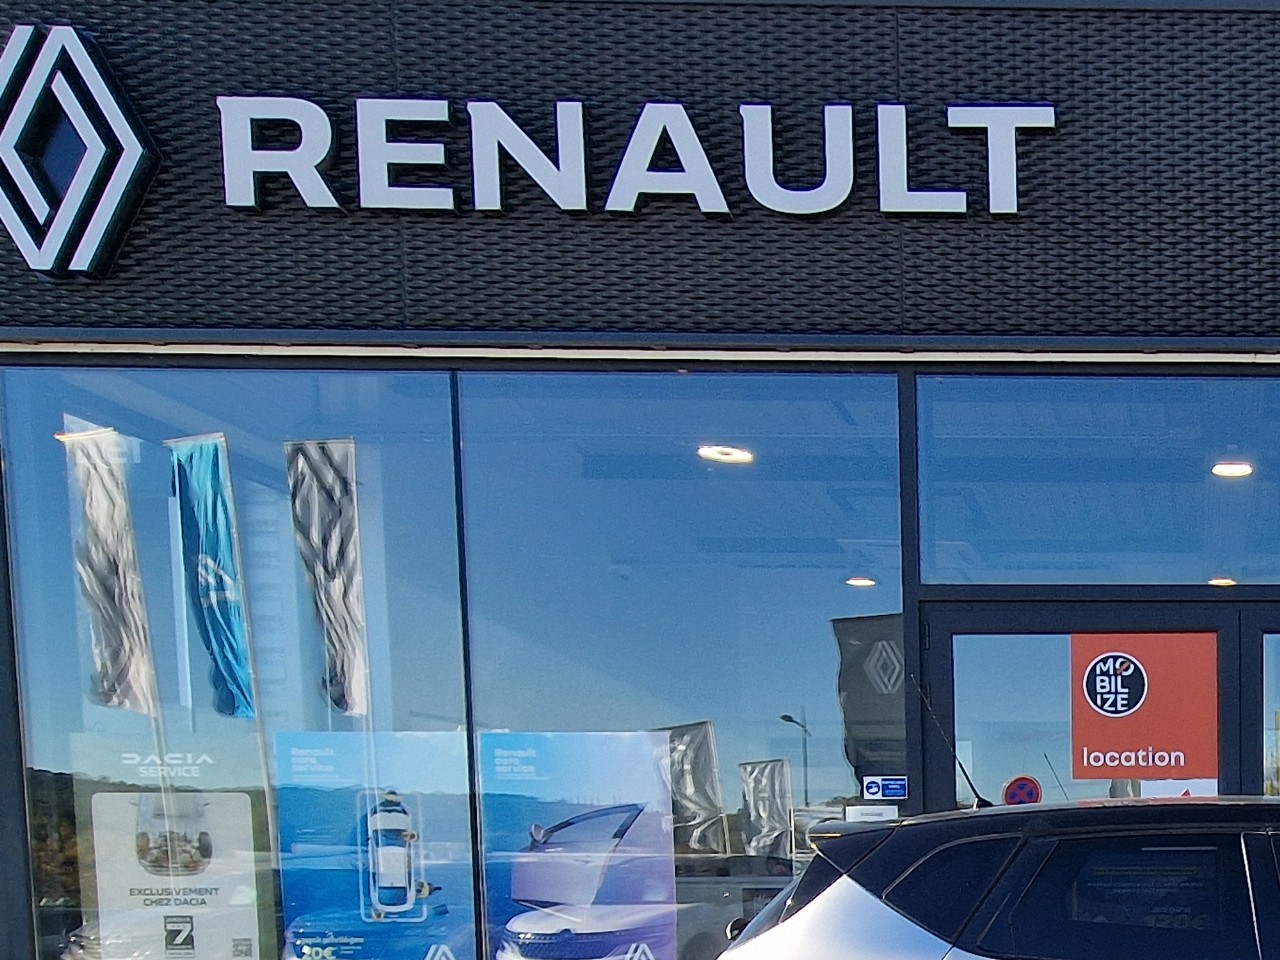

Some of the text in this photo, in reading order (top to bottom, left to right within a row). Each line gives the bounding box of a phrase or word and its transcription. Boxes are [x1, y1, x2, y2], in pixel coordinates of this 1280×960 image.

[216, 96, 1056, 215] RENAULT
[1096, 675, 1129, 693] BIL
[1096, 694, 1129, 711] IZE
[121, 753, 214, 764] DACIA
[1083, 746, 1185, 767] location
[139, 766, 200, 777] SERVICE
[129, 888, 220, 896] EXCLUSIVEMENT
[143, 898, 207, 906] CHEZ DACIA
